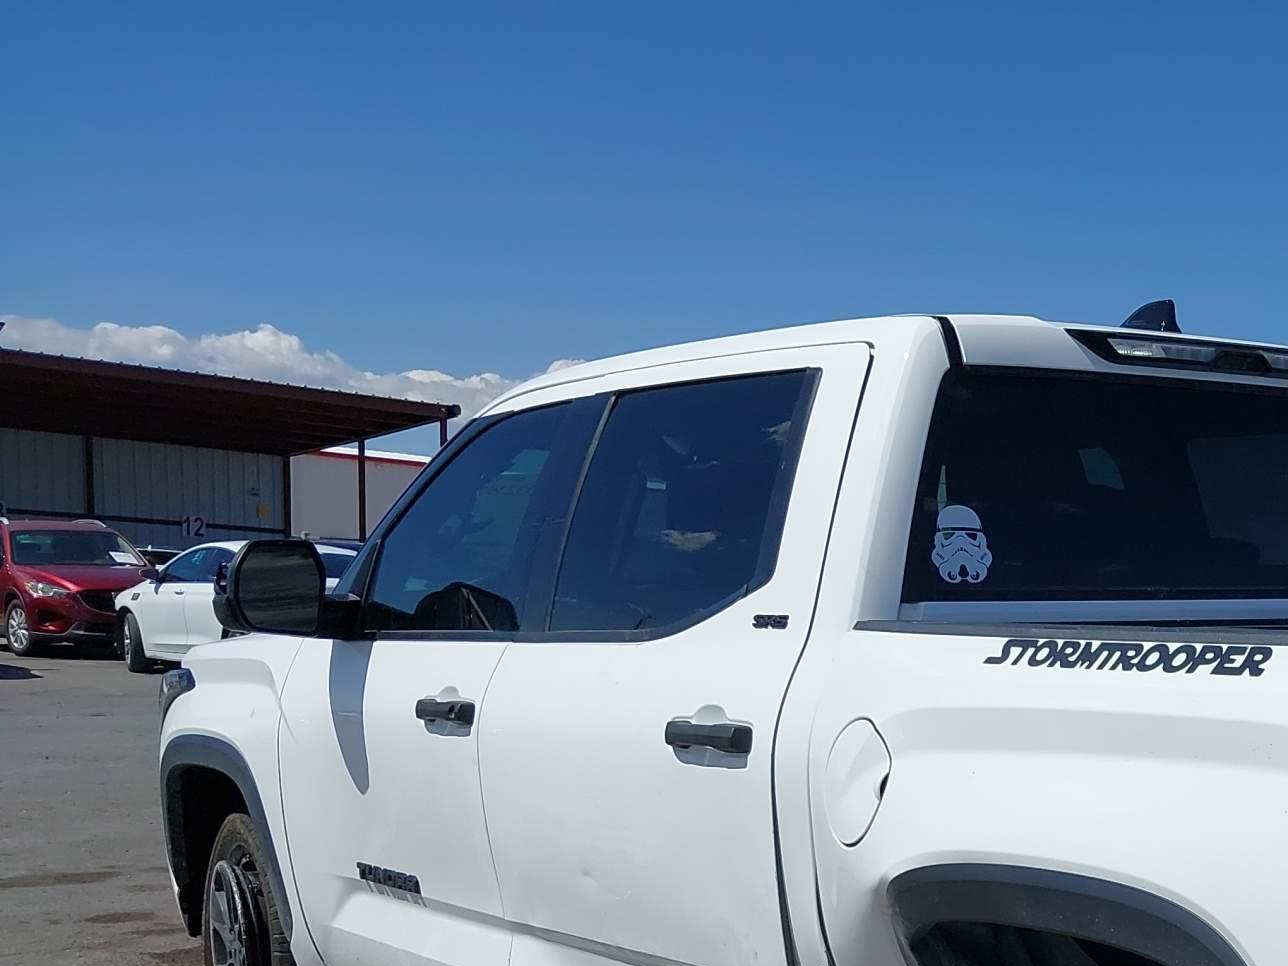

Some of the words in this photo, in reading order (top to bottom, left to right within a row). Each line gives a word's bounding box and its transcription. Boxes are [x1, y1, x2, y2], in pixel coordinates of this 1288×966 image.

[183, 515, 205, 537] 12
[982, 639, 1273, 677] STORMTROOPER
[356, 861, 421, 894] TUNDRA
